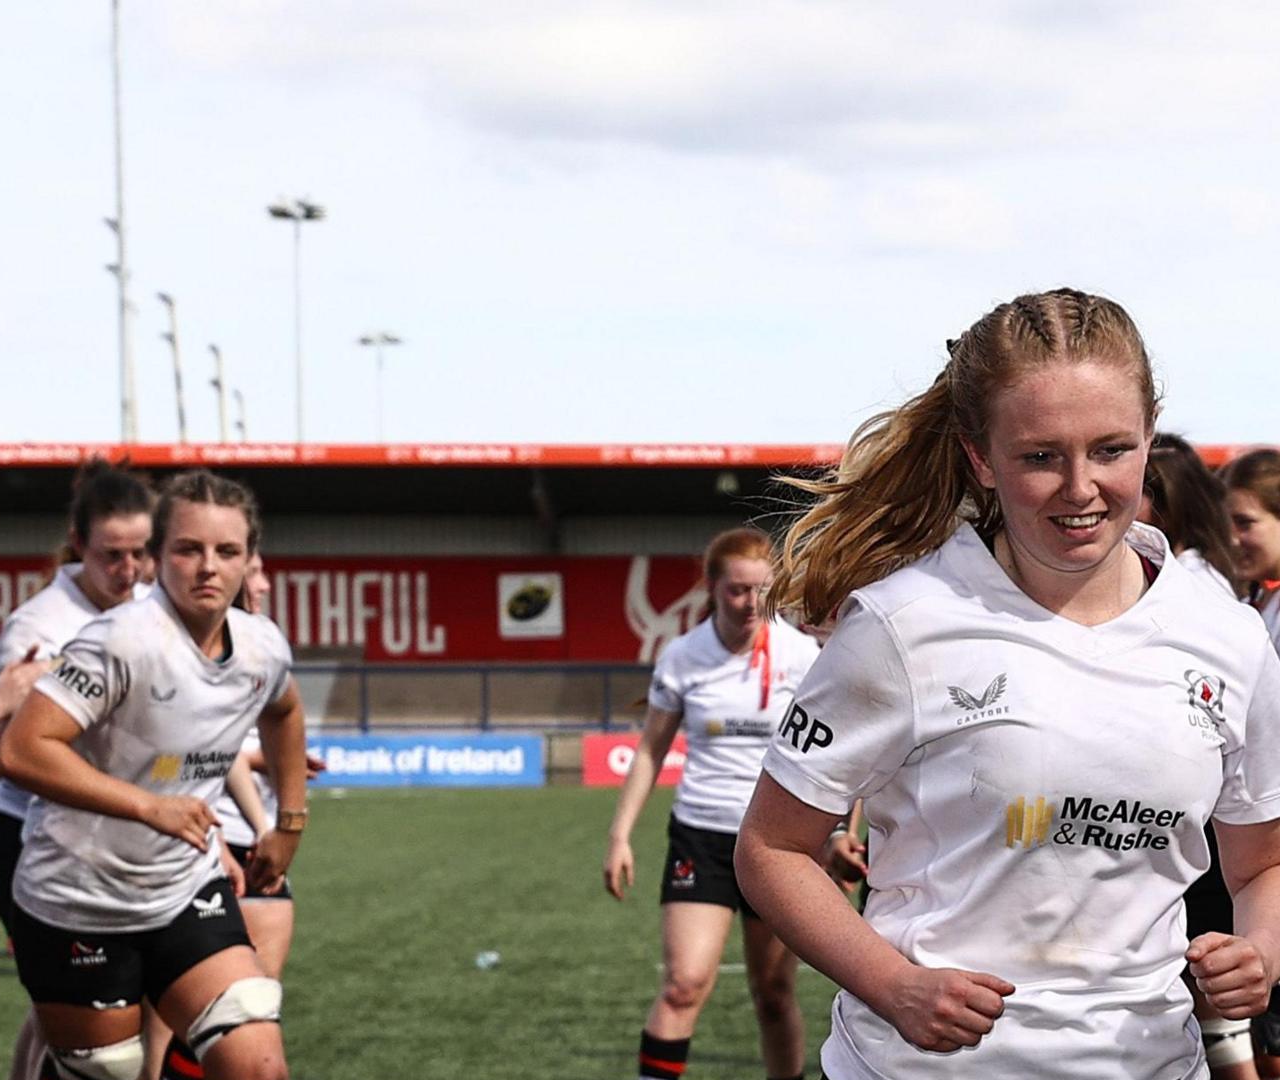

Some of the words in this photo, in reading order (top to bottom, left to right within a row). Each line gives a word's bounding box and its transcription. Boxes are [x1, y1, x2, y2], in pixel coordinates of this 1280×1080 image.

[261, 571, 446, 654] ITHFUL
[778, 699, 833, 754] RP
[956, 705, 1009, 726] CASTORE
[193, 764, 231, 780] Rush
[327, 746, 392, 774] Bank
[396, 746, 424, 774] of
[428, 746, 524, 774] Ireland
[1061, 797, 1185, 828] McAleer
[1053, 823, 1076, 845] &
[1082, 825, 1170, 851] Rushe
